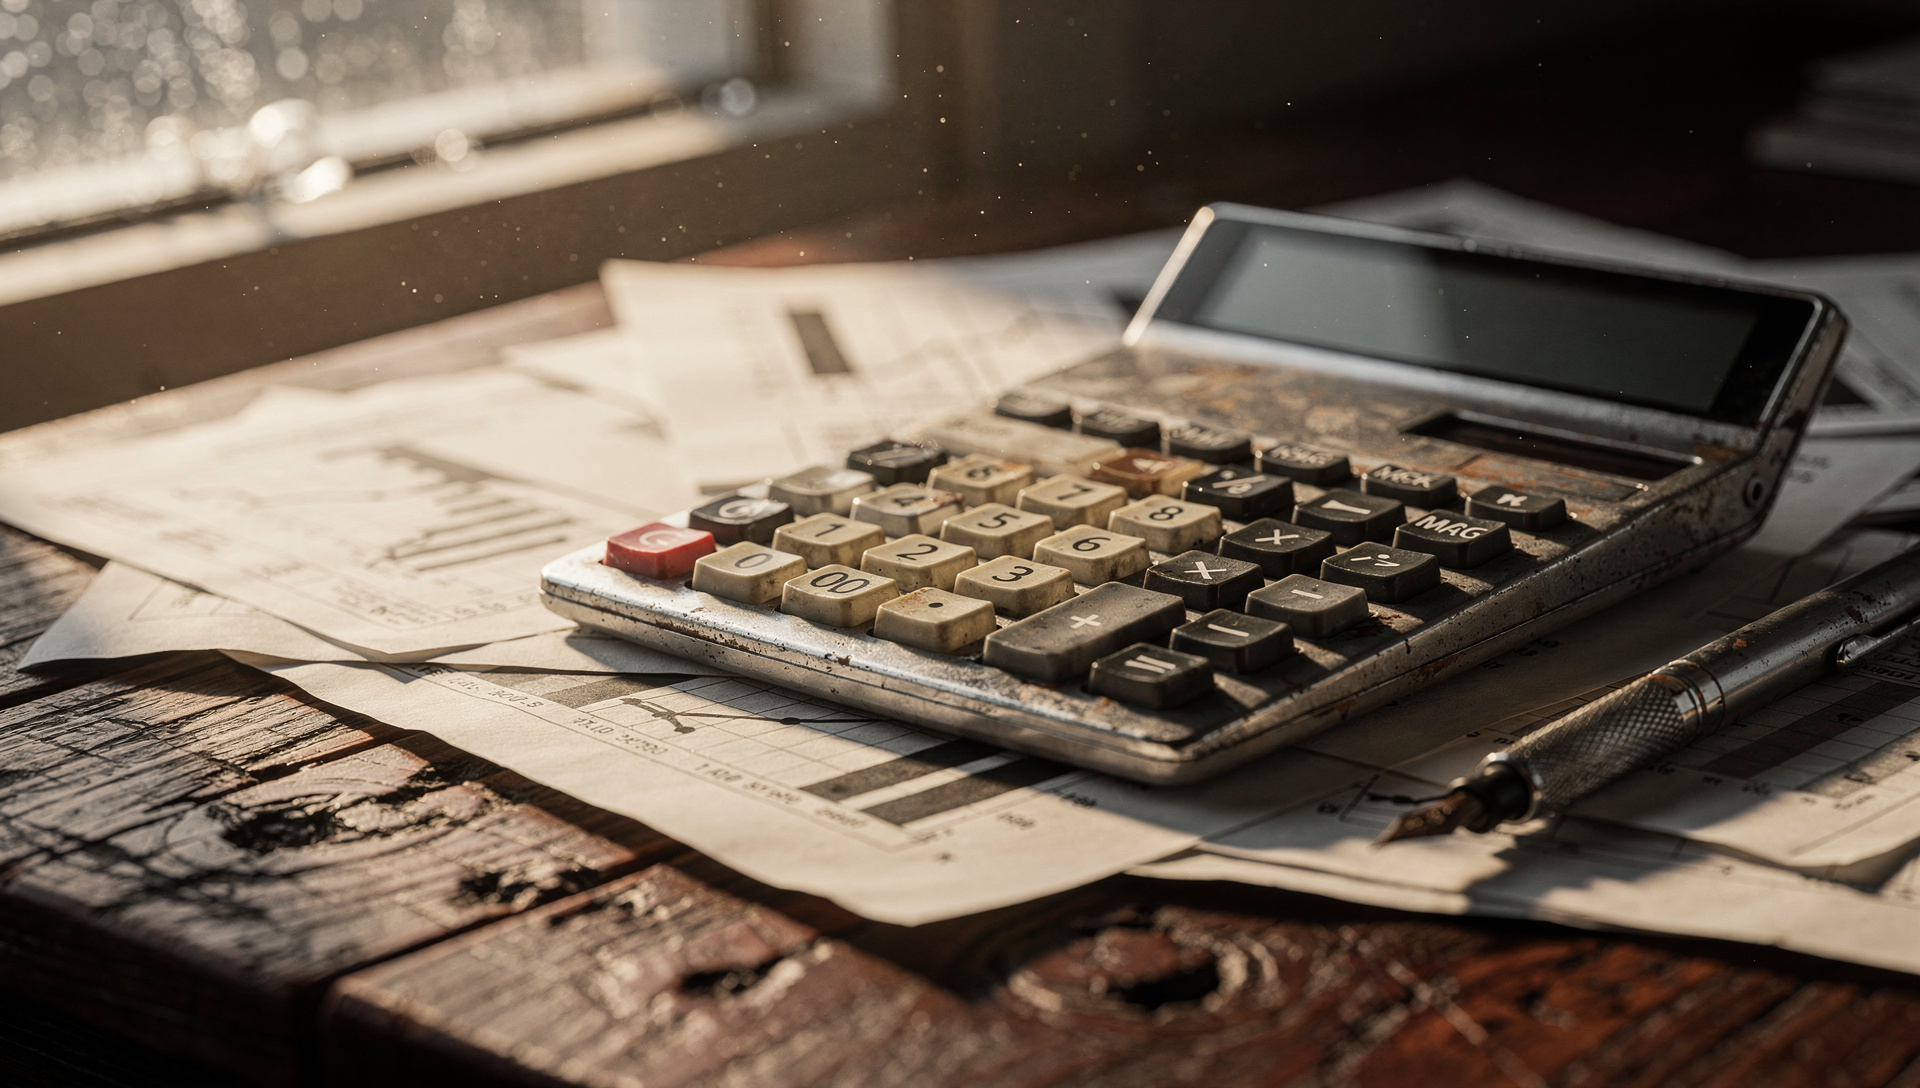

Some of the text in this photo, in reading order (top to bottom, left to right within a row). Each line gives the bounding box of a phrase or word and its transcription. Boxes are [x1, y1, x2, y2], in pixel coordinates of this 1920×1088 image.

[977, 512, 1021, 529] 5
[1149, 506, 1183, 521] 8
[814, 523, 848, 539] 1
[1414, 515, 1489, 540] MAG
[896, 543, 939, 561] 2
[1072, 536, 1111, 552] 6
[734, 552, 774, 569] 0
[810, 571, 871, 594] 00
[992, 565, 1034, 583] 3
